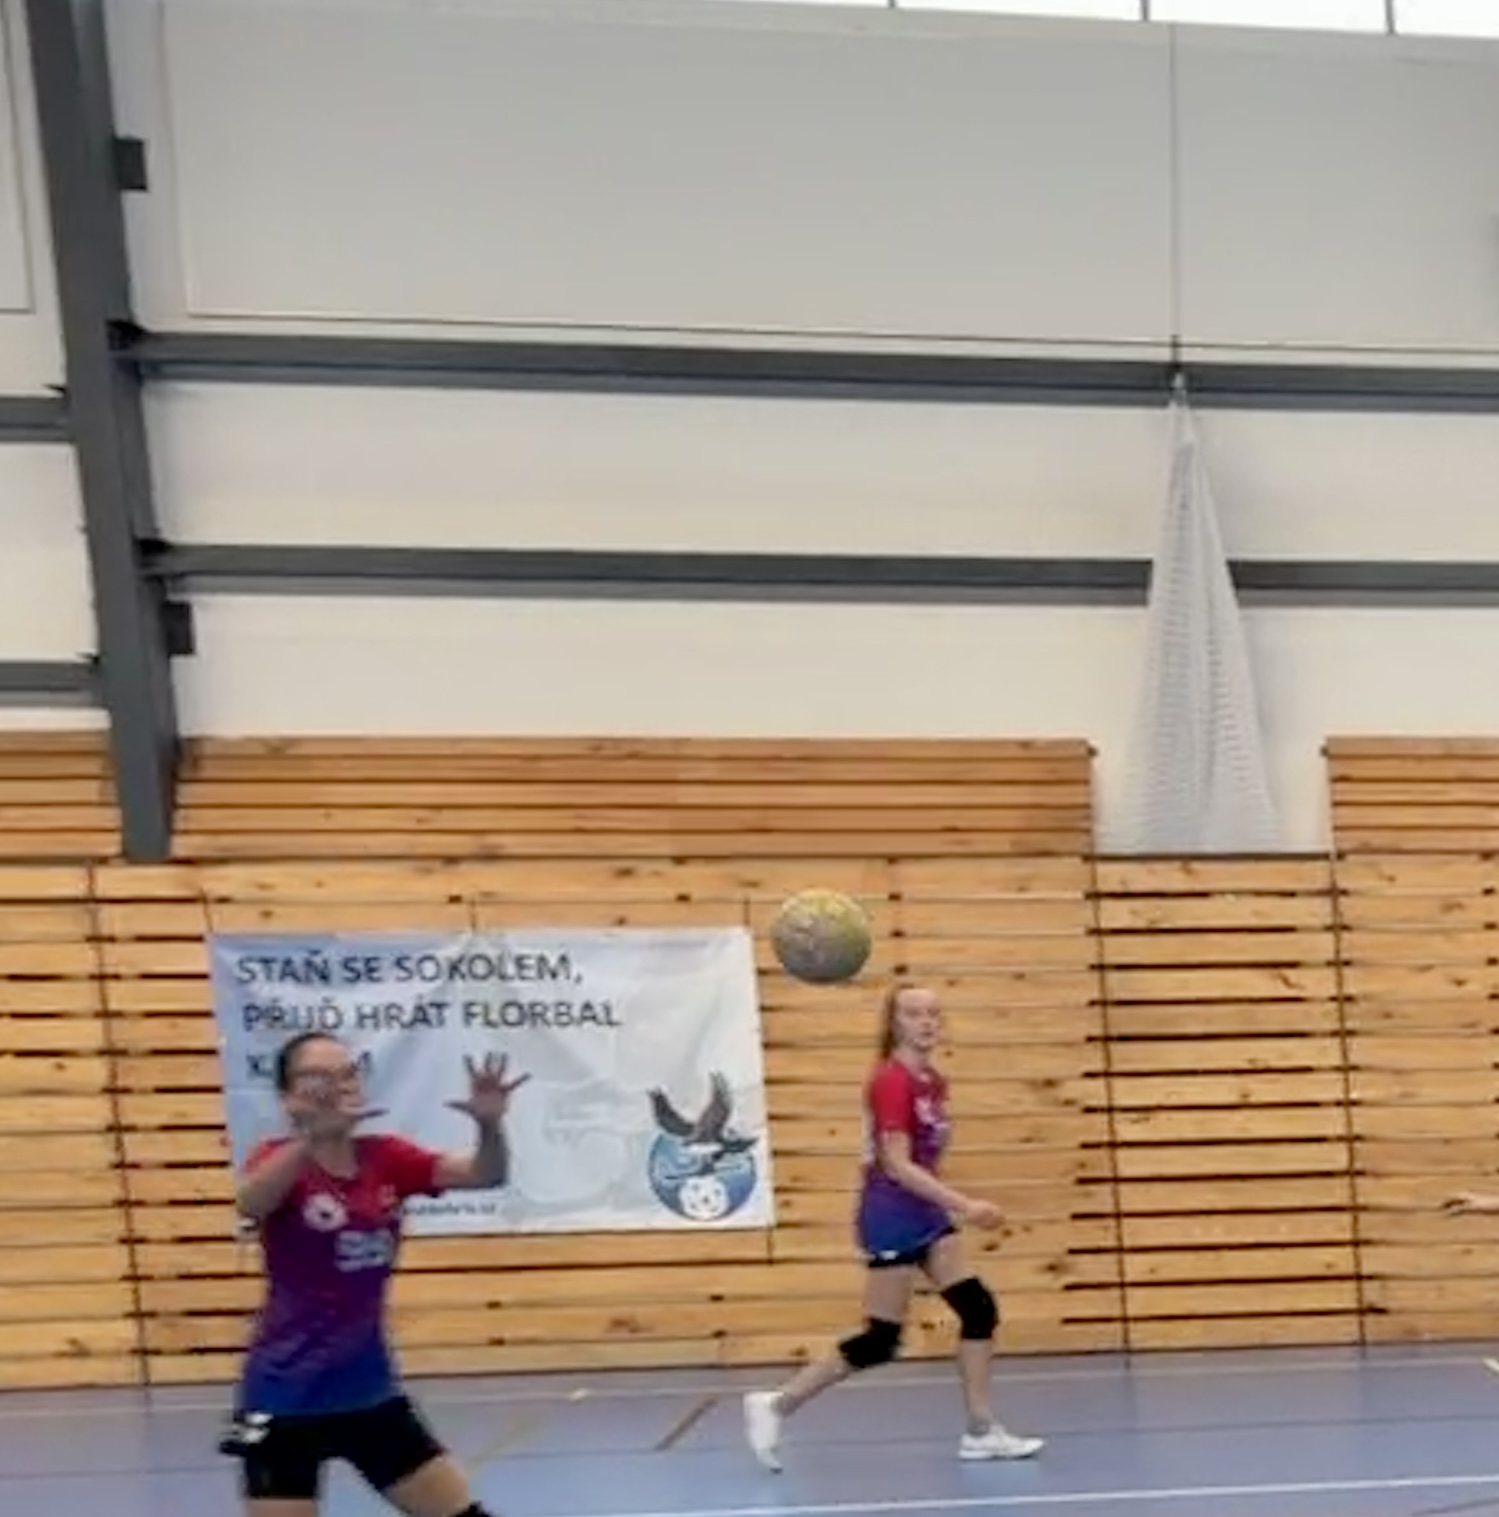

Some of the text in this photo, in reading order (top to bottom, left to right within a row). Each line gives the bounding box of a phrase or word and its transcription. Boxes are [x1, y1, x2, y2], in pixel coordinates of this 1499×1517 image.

[237, 949, 583, 985] STAŇ SE SOKOLEM,
[356, 993, 449, 1030] HRÁT
[463, 999, 623, 1029] FLORBAL
